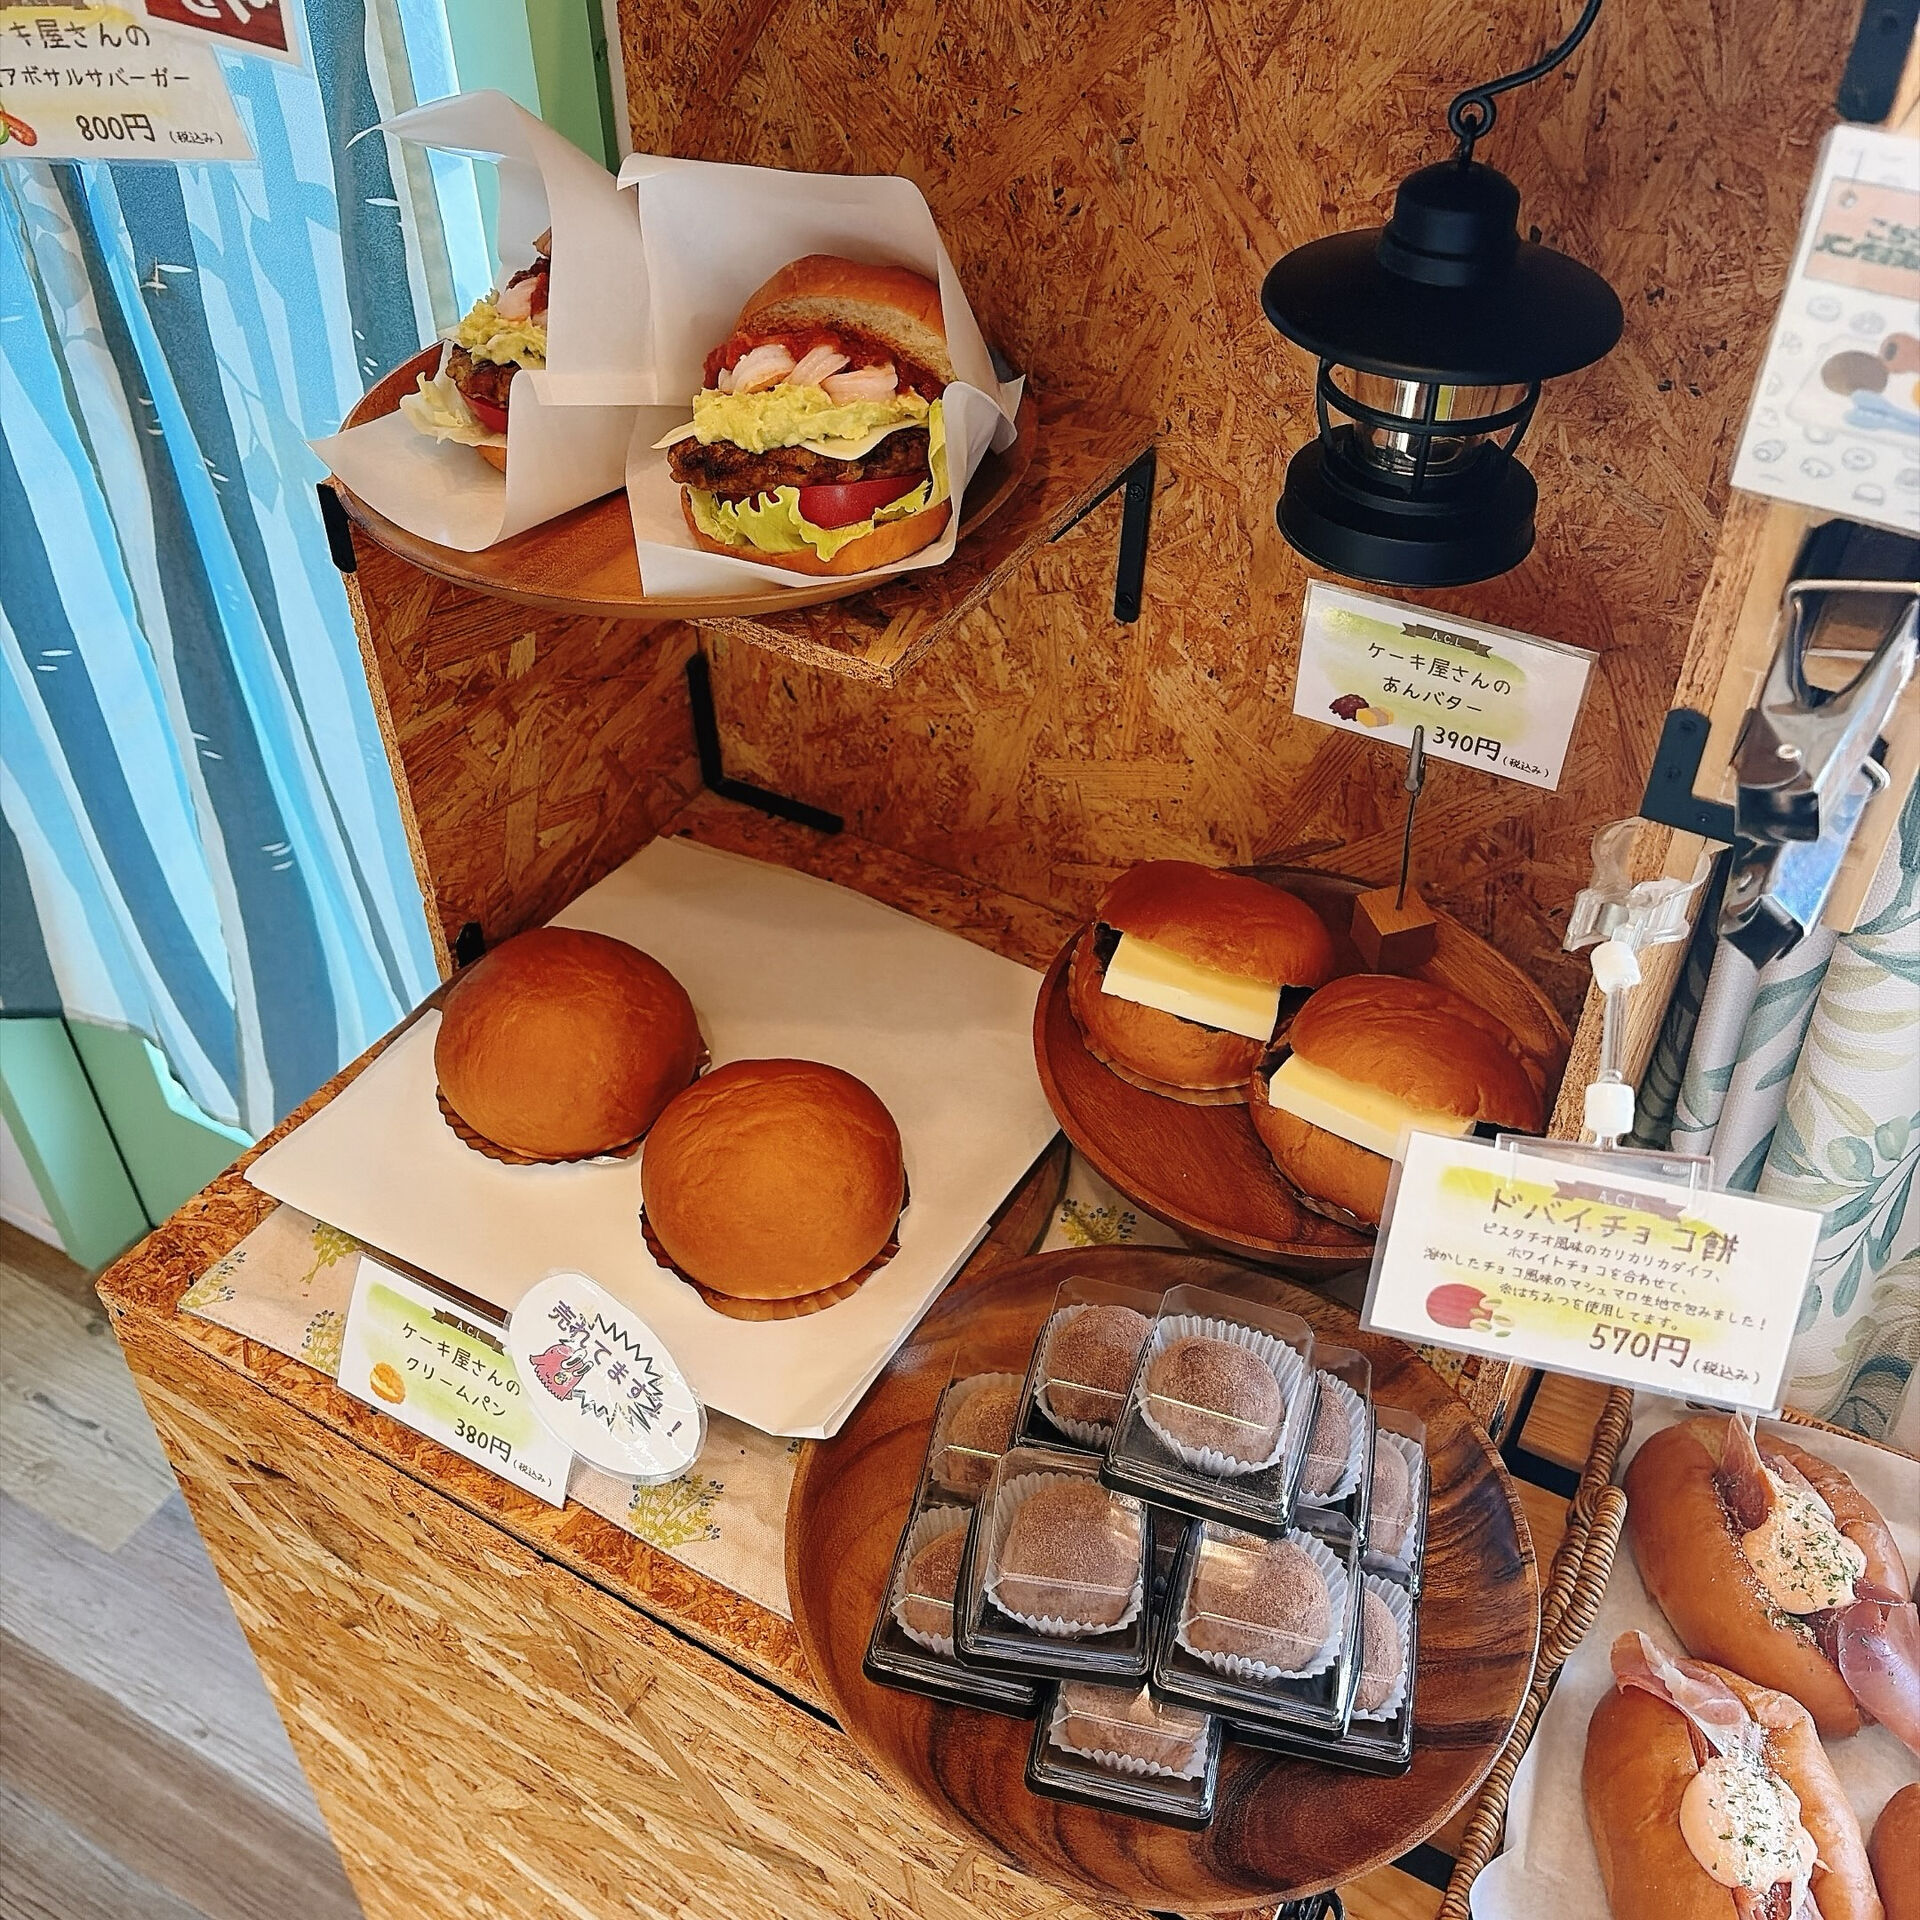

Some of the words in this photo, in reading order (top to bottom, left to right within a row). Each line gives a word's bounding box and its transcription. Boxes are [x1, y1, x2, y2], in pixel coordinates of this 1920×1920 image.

[0, 19, 151, 49] キ屋さんの
[0, 66, 191, 88] アボサルサバーガー
[75, 113, 156, 142] 800円
[1368, 642, 1511, 696] ケーキ屋さんの
[1383, 676, 1482, 713] あんバター
[1432, 725, 1502, 762] 390円
[1491, 1187, 1740, 1265] ドバイチョコ餅
[1506, 1247, 1687, 1295] ホワイトチョコを合わせて、
[402, 1322, 520, 1397] ケーキ屋さんの
[1589, 1322, 1691, 1368] 570円
[406, 1357, 506, 1417] クリームパン
[453, 1418, 512, 1464] 380円
